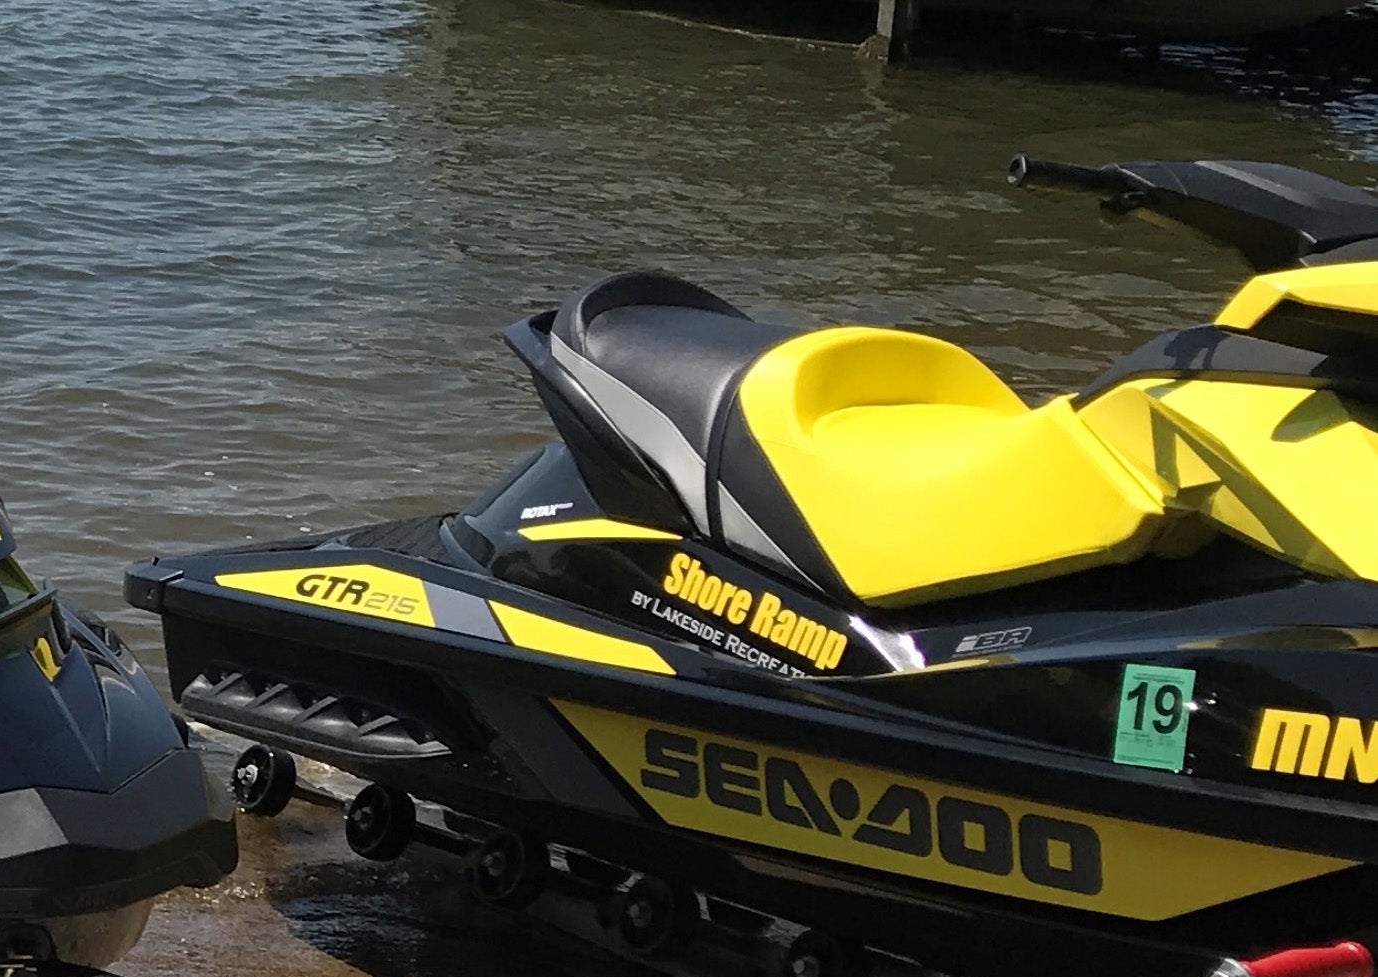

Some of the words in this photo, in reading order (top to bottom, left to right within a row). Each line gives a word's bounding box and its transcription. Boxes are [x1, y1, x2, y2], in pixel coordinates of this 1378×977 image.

[296, 574, 370, 605] GTR
[364, 592, 420, 615] 215
[631, 590, 653, 610] BY
[651, 597, 725, 646] LAKESIDE
[663, 552, 753, 625] Shore
[750, 592, 848, 671] Ramp
[1127, 681, 1183, 735] 19
[1252, 708, 1378, 784] MN
